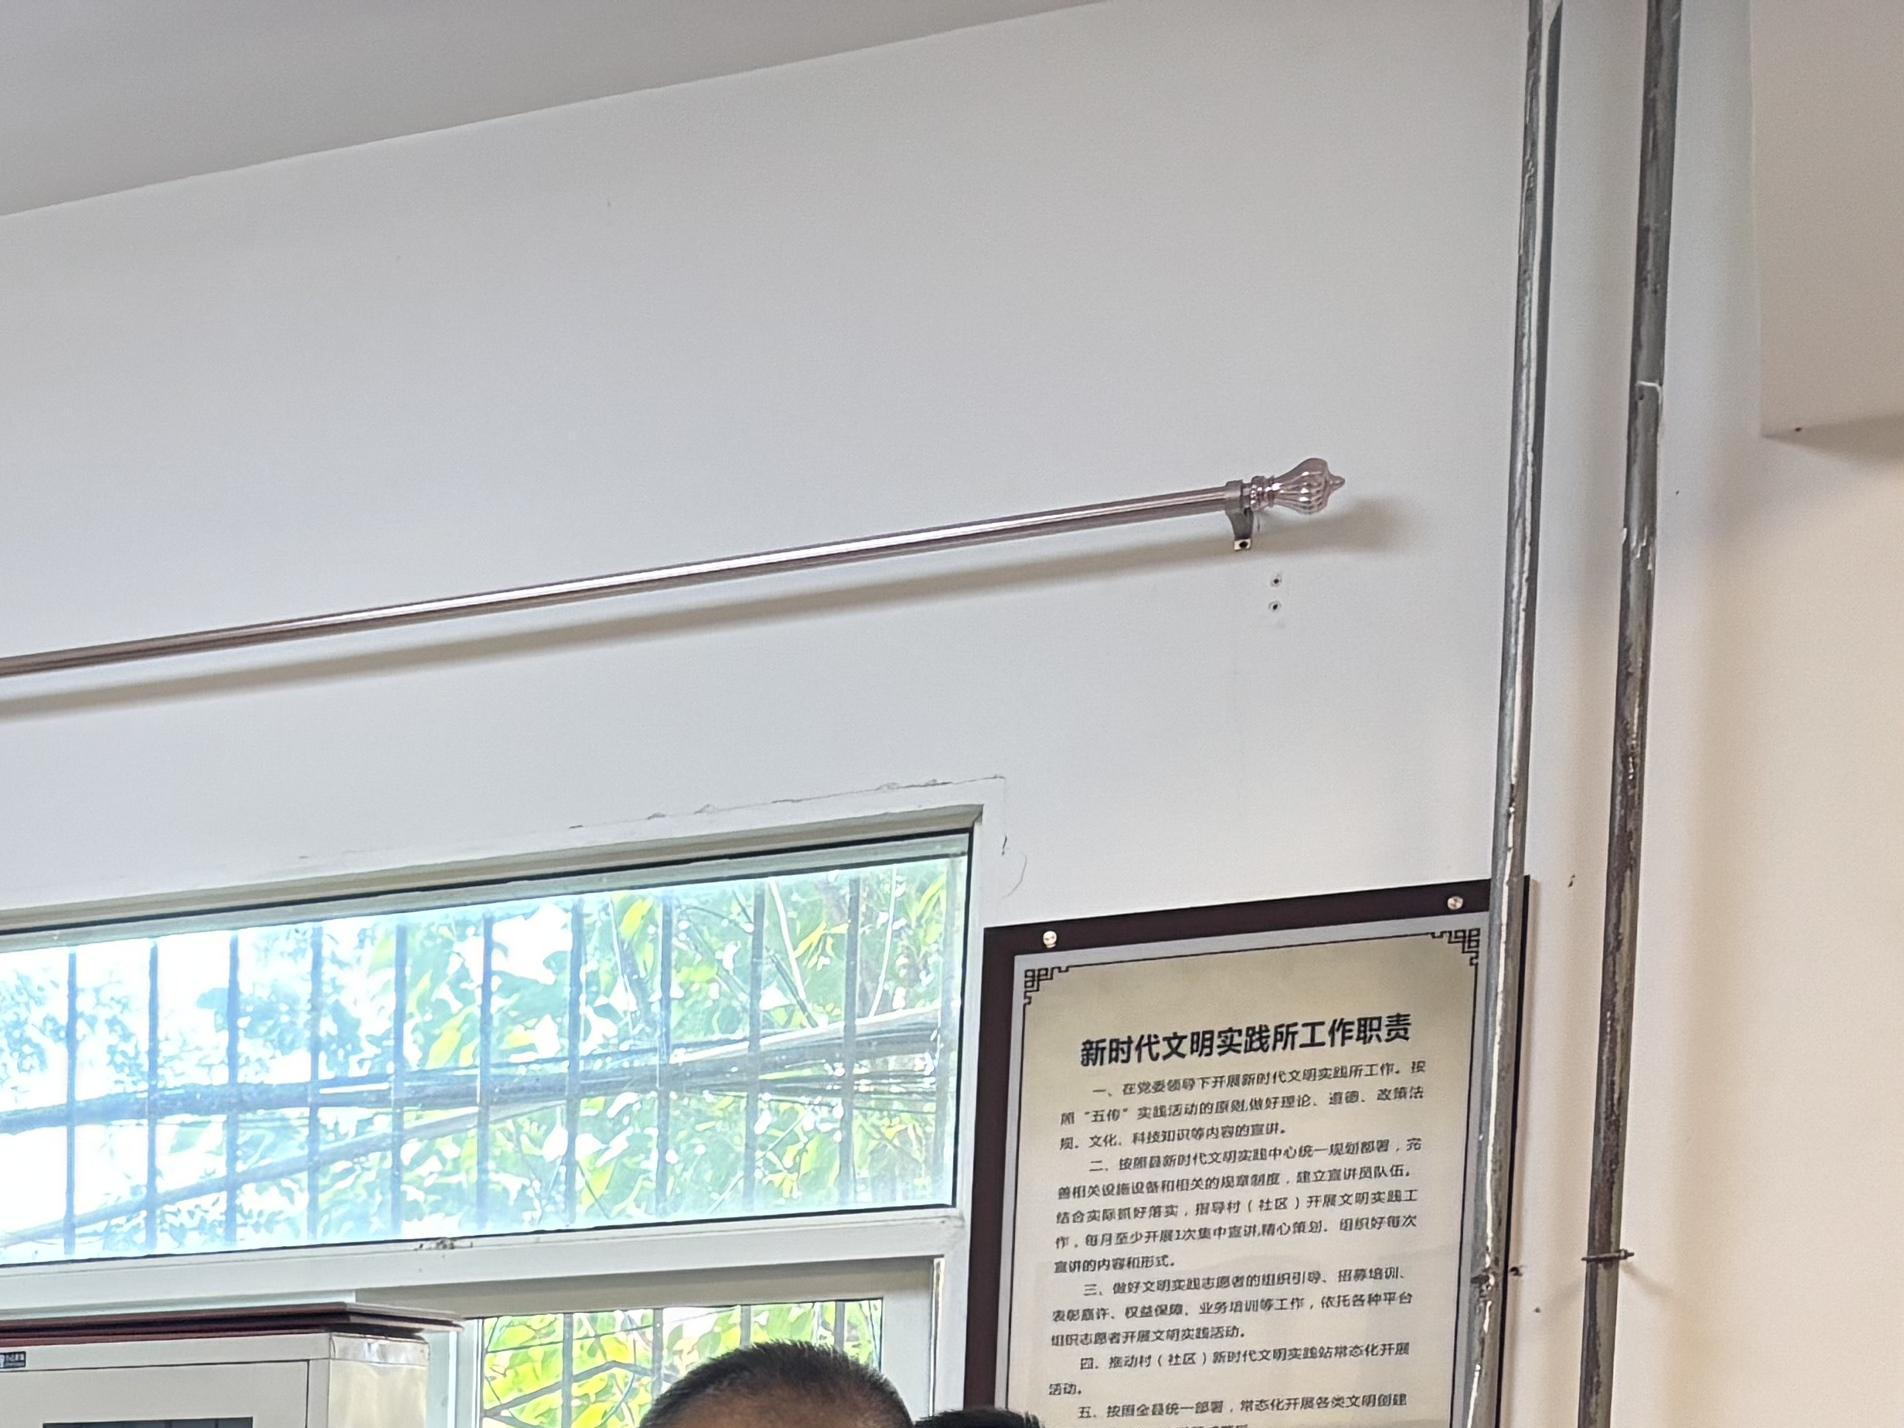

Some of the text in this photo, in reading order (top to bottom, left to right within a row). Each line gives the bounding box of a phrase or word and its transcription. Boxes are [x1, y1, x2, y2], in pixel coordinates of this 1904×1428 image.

[1079, 1013, 1413, 1067] 新时代文明实践所工作职责
